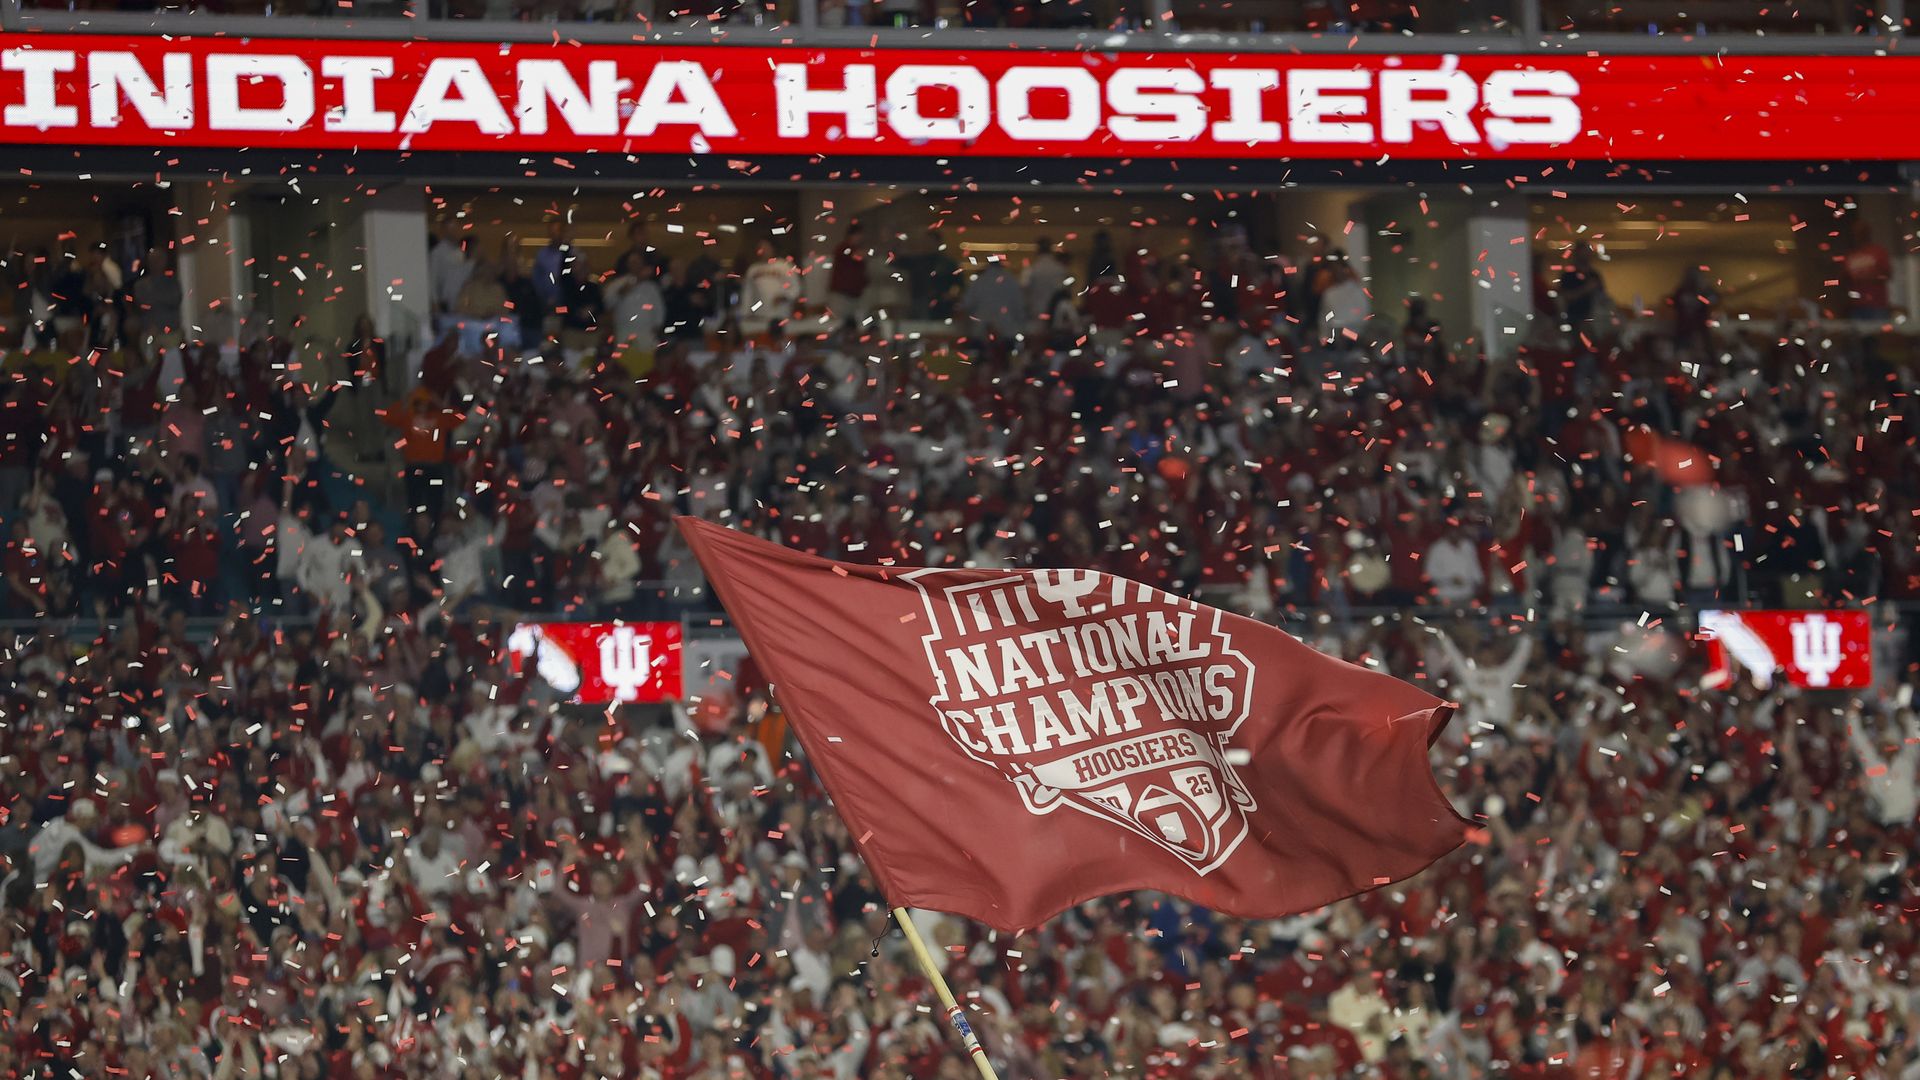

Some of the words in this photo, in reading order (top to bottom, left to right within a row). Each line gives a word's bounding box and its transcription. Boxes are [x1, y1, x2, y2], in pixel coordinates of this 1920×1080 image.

[2, 49, 738, 137] INDIANA
[775, 63, 1582, 144] HOOSIERS
[945, 611, 1211, 702] NATIONAL
[945, 664, 1236, 756] CHAMPIONS
[1072, 732, 1198, 783] HOOSIERS
[1185, 773, 1213, 798] 25
